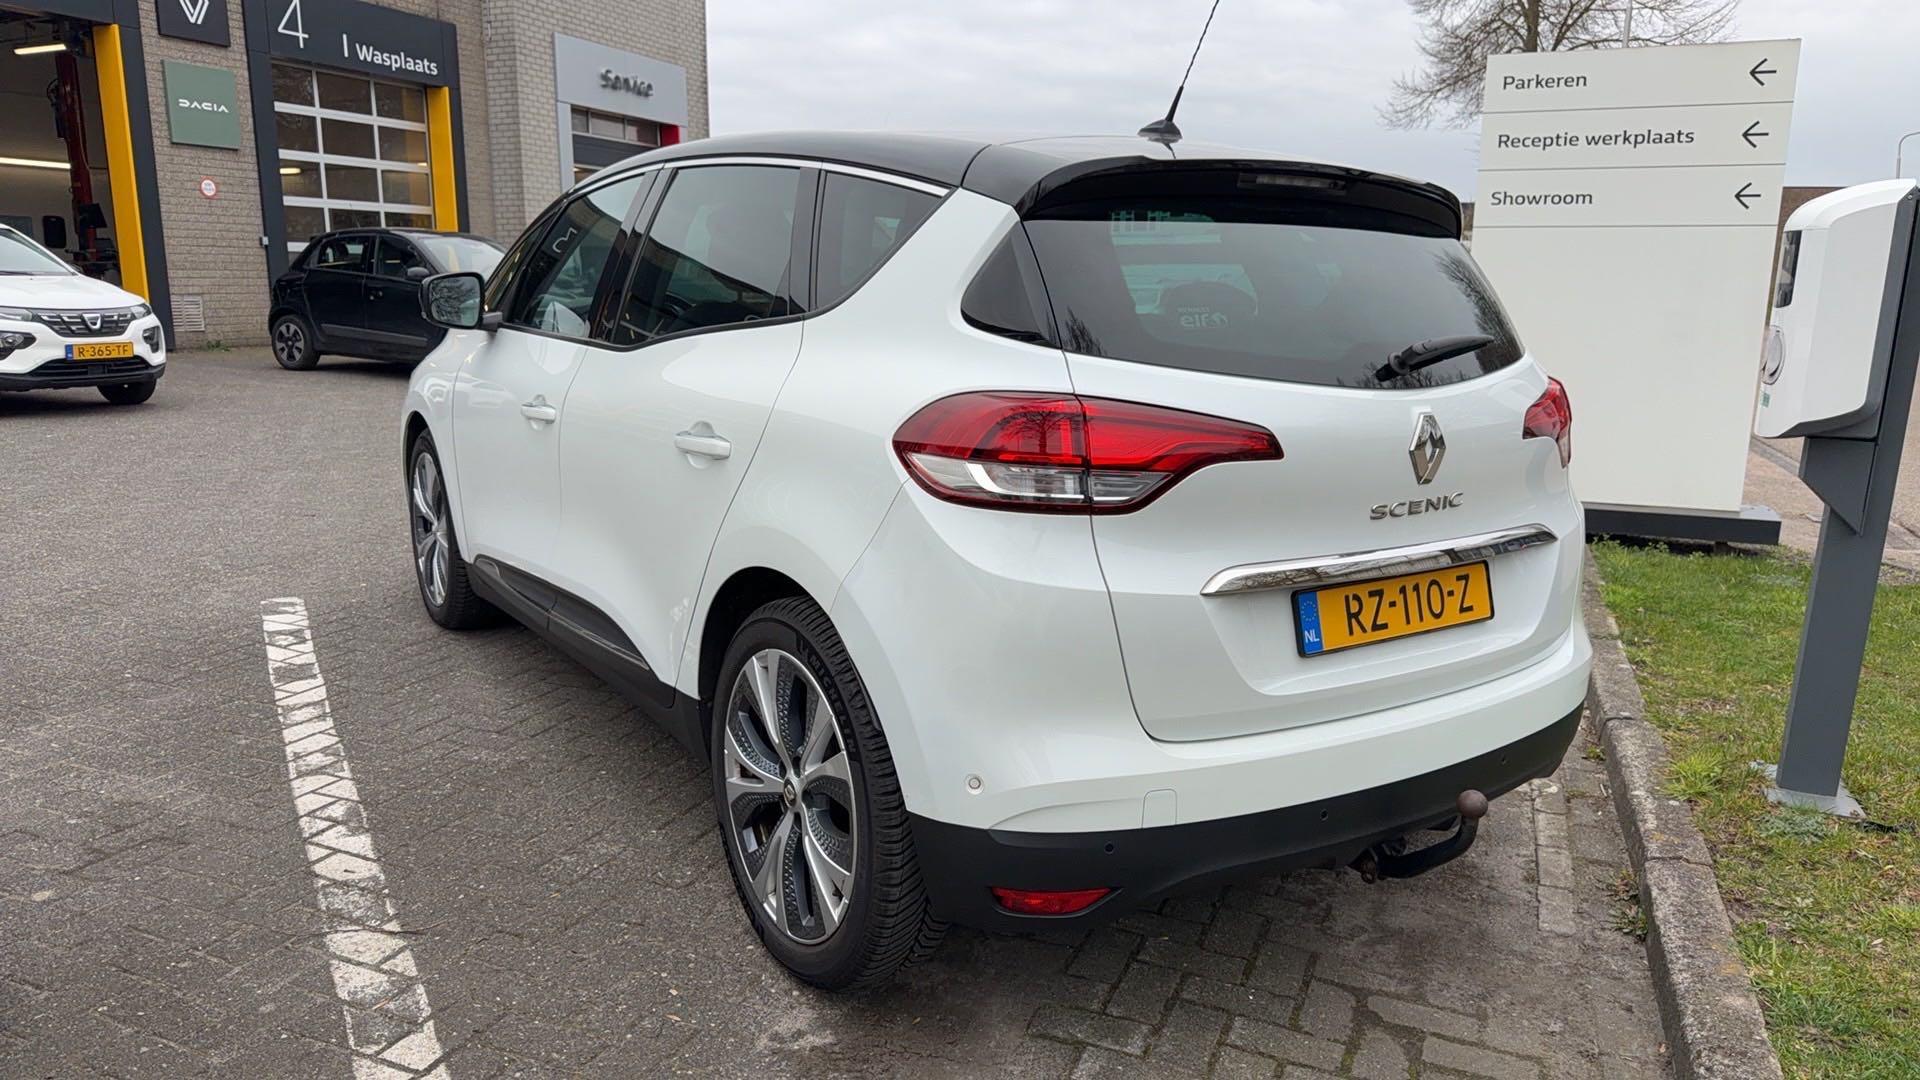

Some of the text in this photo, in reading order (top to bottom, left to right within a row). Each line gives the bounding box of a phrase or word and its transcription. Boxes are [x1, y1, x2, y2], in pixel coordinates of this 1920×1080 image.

[277, 0, 309, 48] 4
[355, 42, 439, 76] Wasplaats
[1502, 74, 1588, 91] Parkeren
[178, 98, 230, 114] DACIA
[1498, 128, 1696, 151] Receptie werkplaats
[1490, 190, 1594, 206] Showroom
[78, 344, 129, 358] R-365-TF
[1369, 491, 1464, 521] SCENIC
[1344, 573, 1474, 637] RZ-110-Z
[1304, 629, 1320, 644] NL
